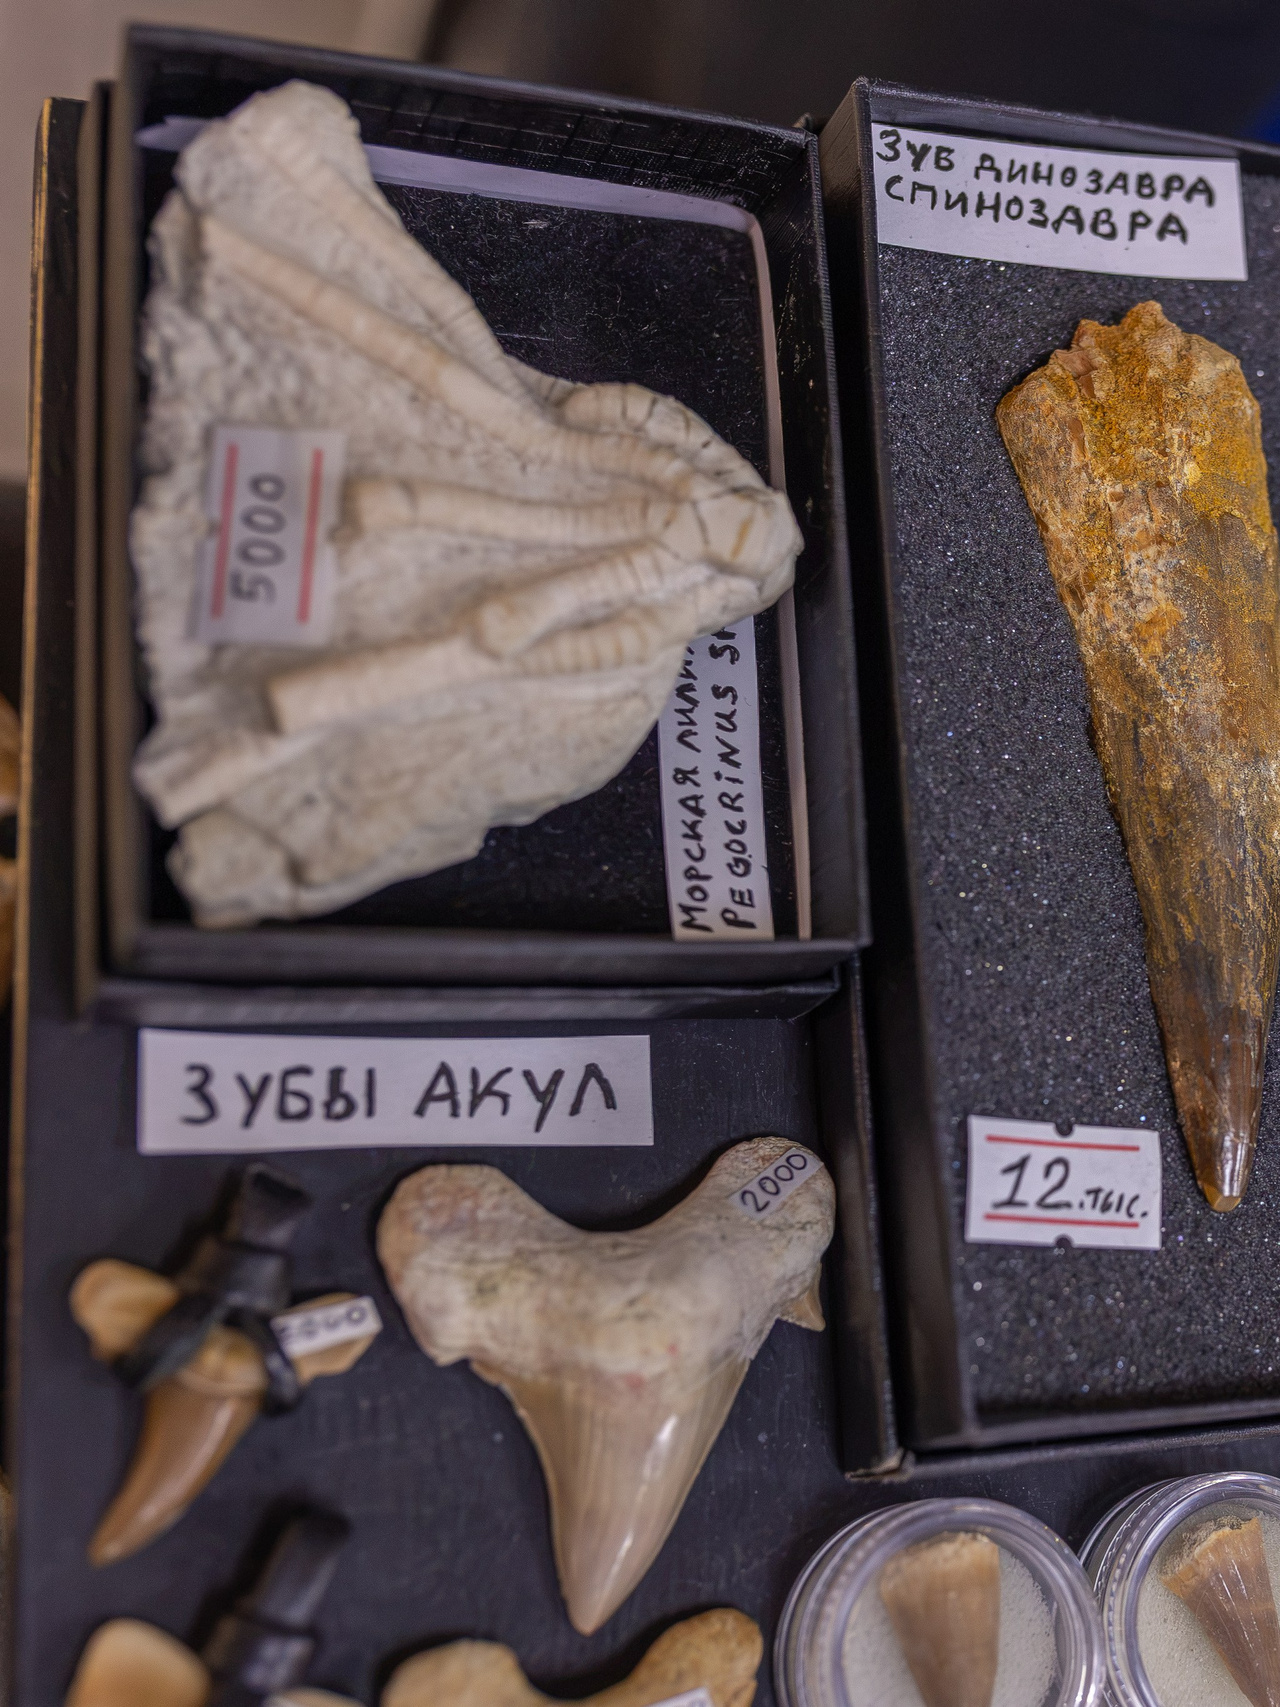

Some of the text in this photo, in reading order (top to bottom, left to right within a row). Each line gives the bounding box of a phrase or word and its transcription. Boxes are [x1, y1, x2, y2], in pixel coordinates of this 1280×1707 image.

[885, 174, 1188, 245] СПИНОЗАВРА
[974, 152, 1215, 208] ДИНОЗАВРА
[229, 472, 286, 607] 5000
[673, 646, 715, 933] МОРСКАЯ ЛИЛИ
[180, 1061, 617, 1133] ЗУБЫ АКУЛ
[741, 1153, 807, 1213] 2000
